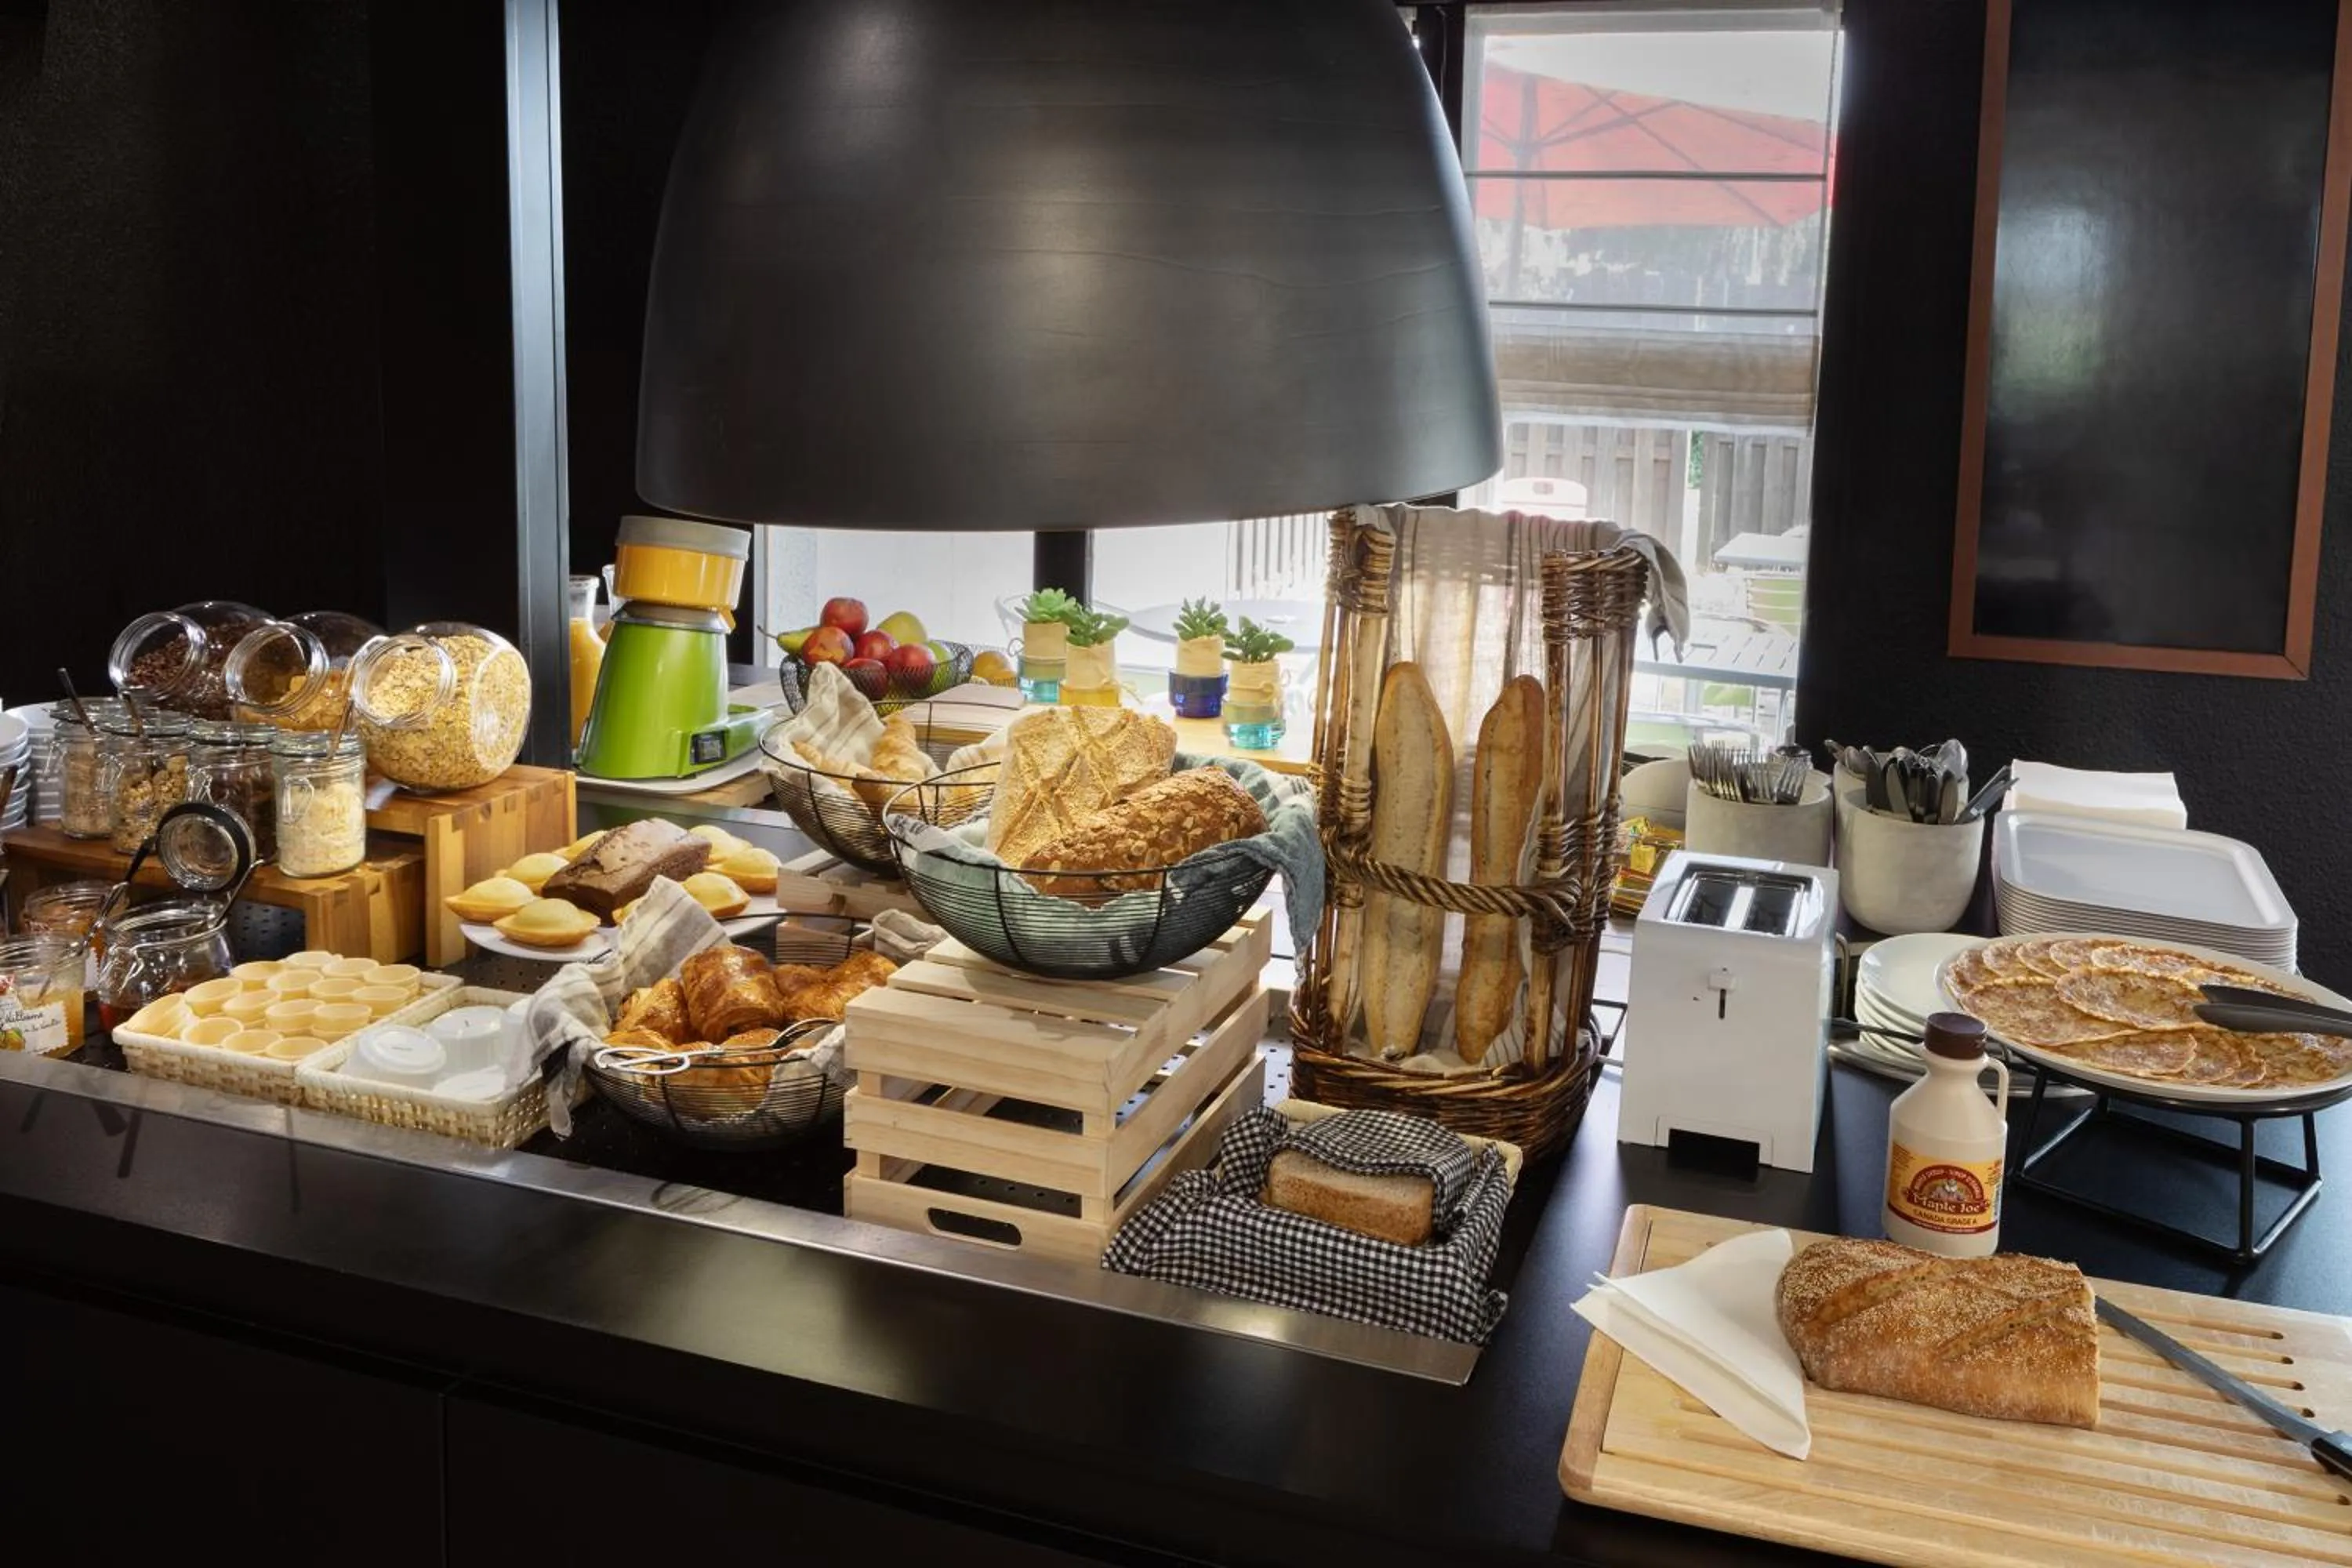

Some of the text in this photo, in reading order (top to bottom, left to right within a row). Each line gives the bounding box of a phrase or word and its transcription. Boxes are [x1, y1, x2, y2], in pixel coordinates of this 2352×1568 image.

[1913, 1192, 1980, 1213] Maple Joe
[1913, 1208, 1944, 1223] CANADA
